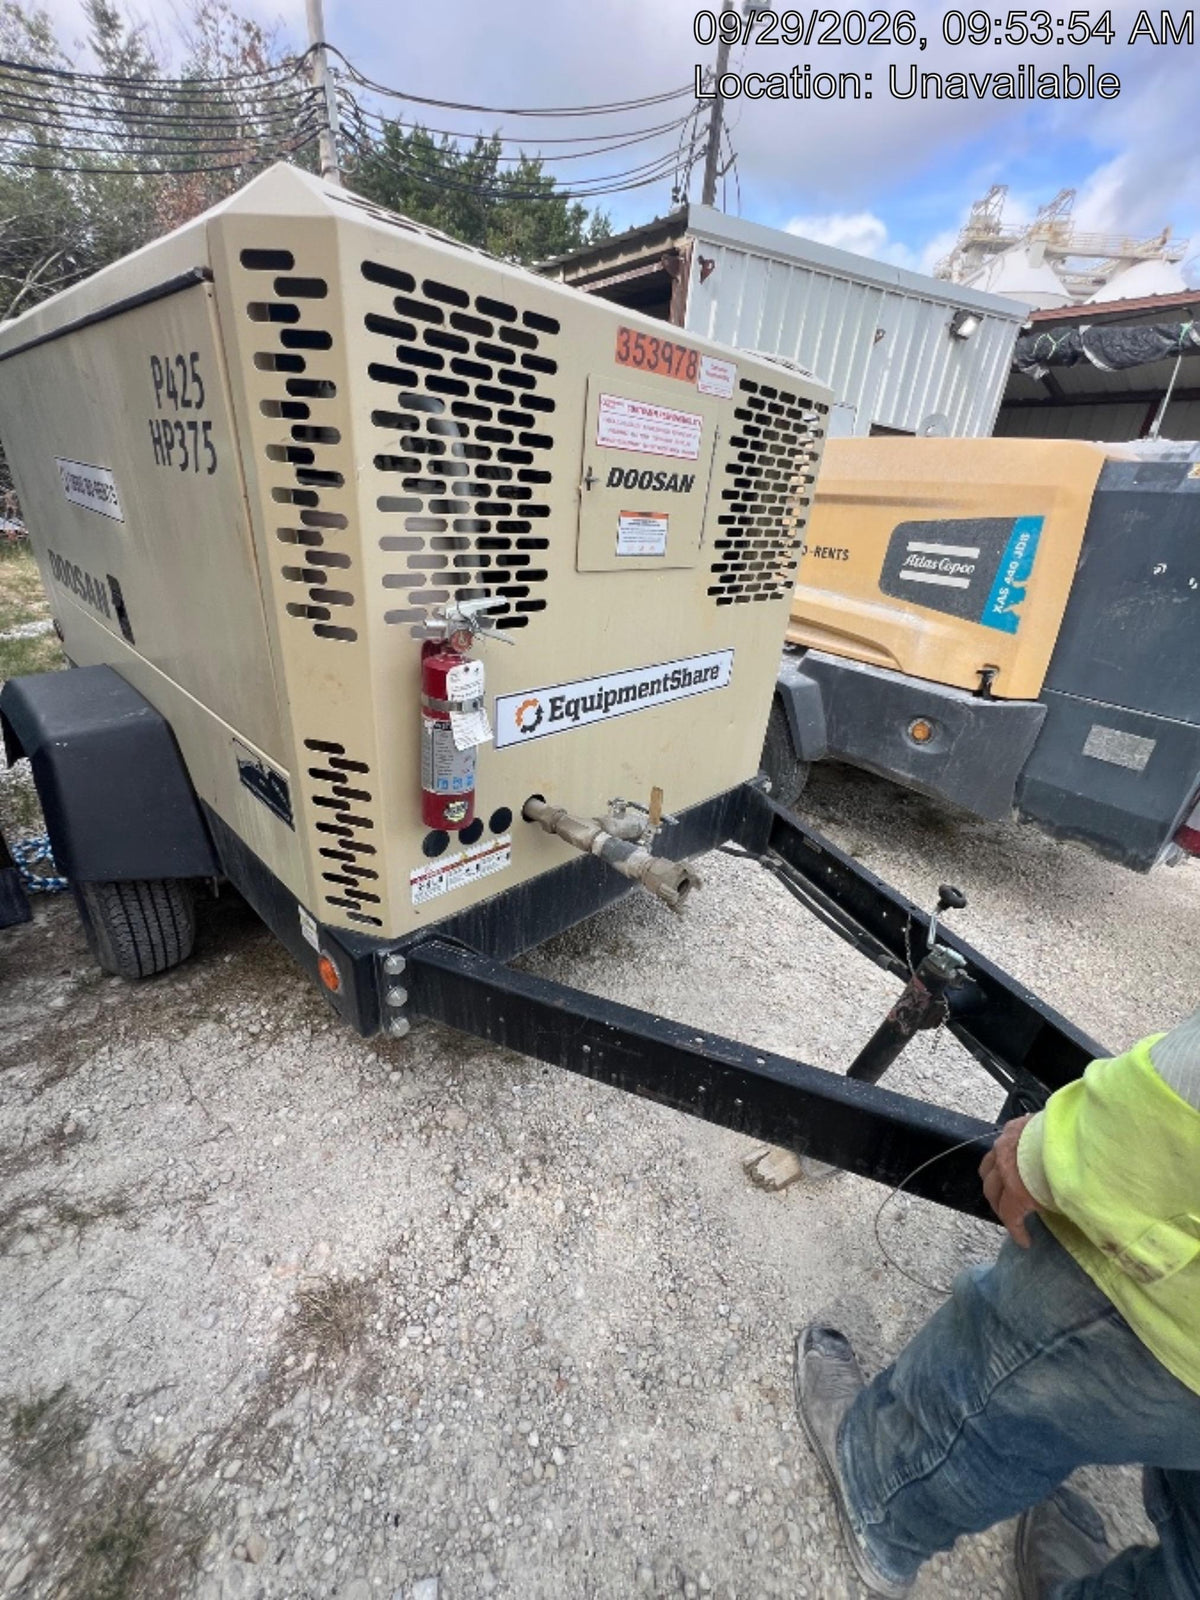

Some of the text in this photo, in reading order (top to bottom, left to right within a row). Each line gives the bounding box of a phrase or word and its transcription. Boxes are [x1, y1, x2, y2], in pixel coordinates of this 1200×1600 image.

[617, 327, 698, 379] 353978
[150, 352, 205, 411] P425
[149, 419, 217, 475] HP375
[606, 467, 696, 493] DOOSAN
[47, 548, 112, 620] DOOSAN
[902, 553, 975, 575] Atlas Copco
[992, 587, 1010, 615] XAS
[1004, 561, 1020, 585] 440
[548, 664, 721, 722] EquipmentShare
